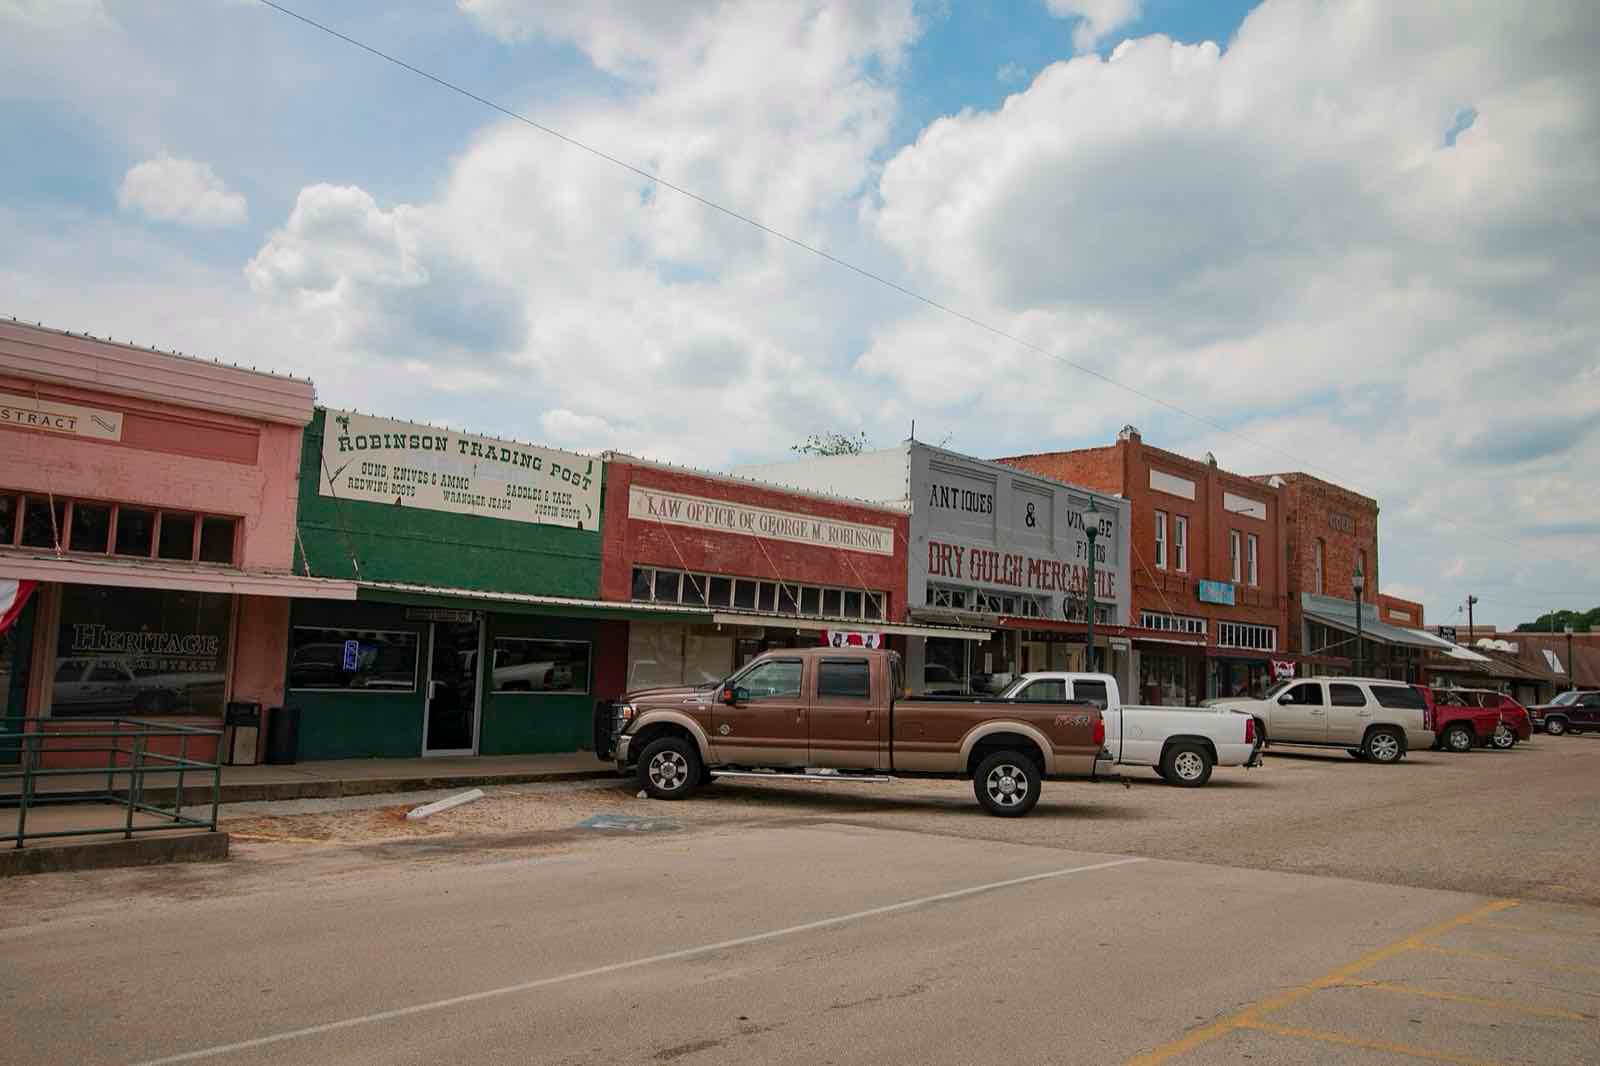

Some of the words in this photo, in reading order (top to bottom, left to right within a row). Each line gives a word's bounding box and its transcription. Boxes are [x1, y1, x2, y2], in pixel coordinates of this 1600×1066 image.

[337, 434, 448, 452] ROBINSON
[458, 439, 543, 471] TRADING
[550, 462, 592, 490] POST
[393, 466, 429, 484] KNIVES
[440, 474, 470, 490] AMMO
[391, 483, 416, 497] BOOTS
[443, 490, 486, 507] WRANGLER
[488, 497, 512, 511] JEANS
[506, 484, 542, 501] SADDLES
[561, 507, 580, 520] BOOTS
[646, 495, 682, 518] LAW
[687, 503, 736, 528] OFFICE
[739, 511, 755, 530] OF
[759, 515, 808, 538] GEORGE
[812, 524, 825, 541] M.
[828, 526, 883, 549] ROBINSON
[929, 484, 993, 514] ANTIQUES
[1025, 502, 1036, 528] &
[1067, 509, 1112, 538] VINGE
[1076, 540, 1106, 563] FIDS
[927, 541, 965, 579] DRY
[969, 548, 1023, 588] GULCH
